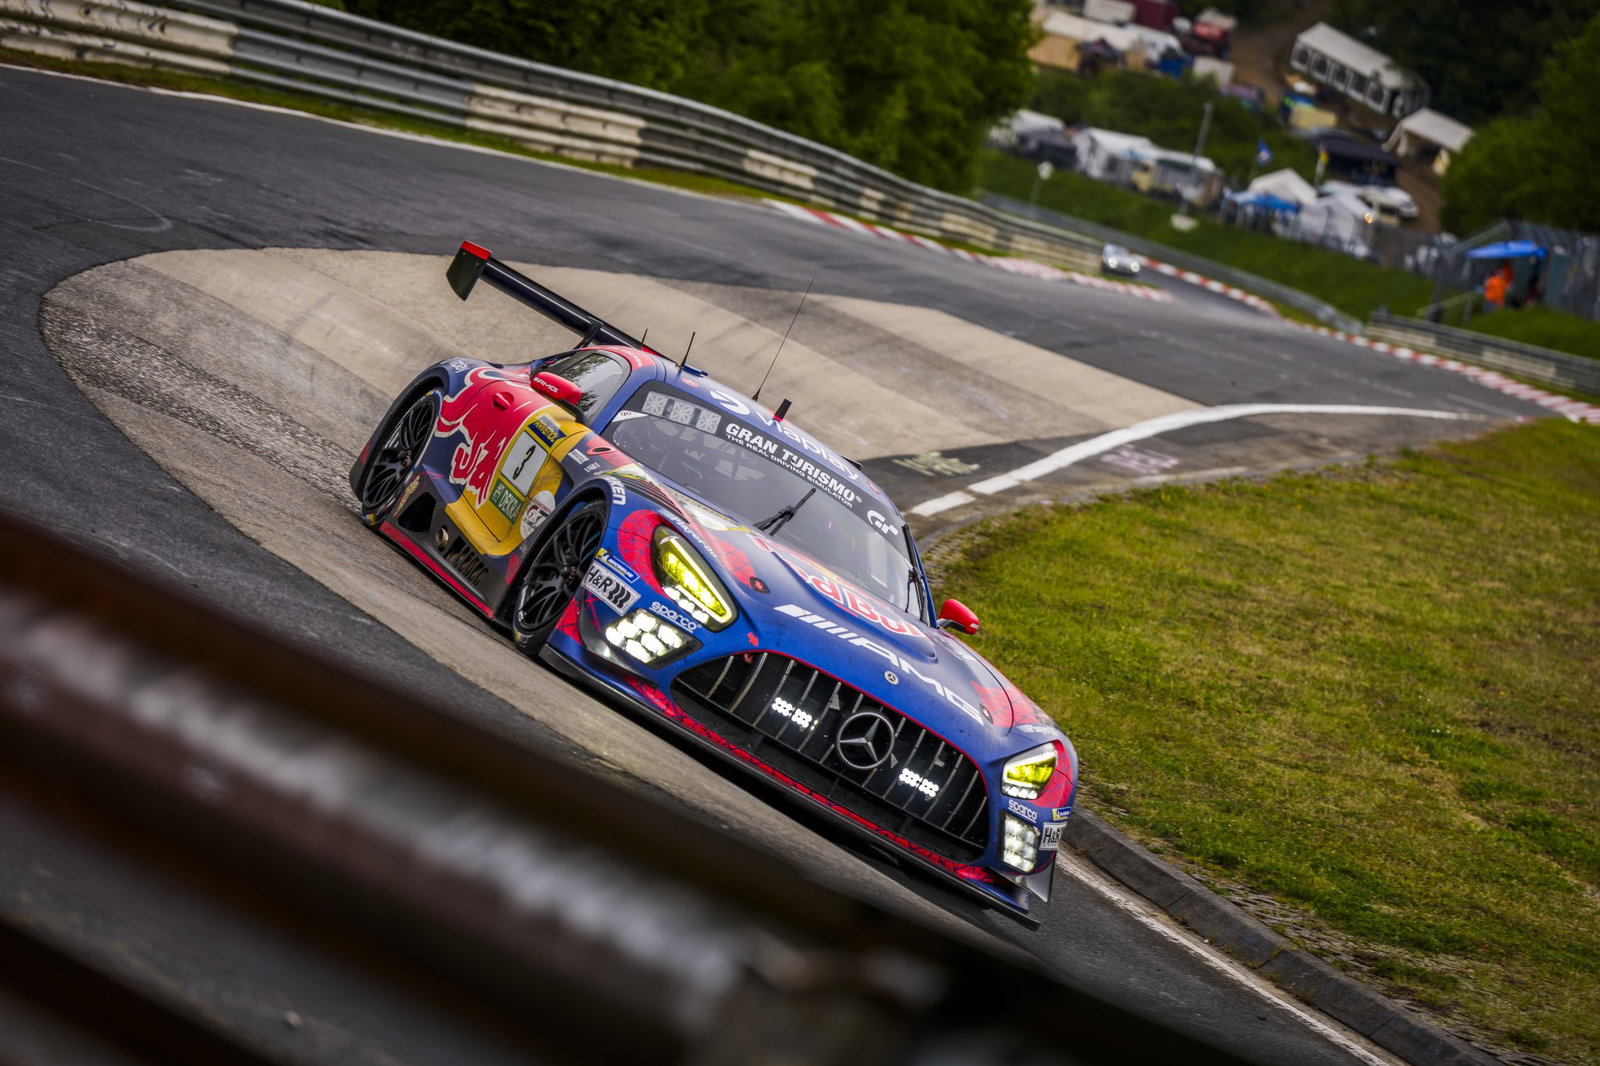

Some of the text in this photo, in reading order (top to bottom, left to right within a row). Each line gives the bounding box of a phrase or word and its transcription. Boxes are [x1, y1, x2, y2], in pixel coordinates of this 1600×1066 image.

[725, 422, 779, 455] GRAN
[512, 444, 536, 480] 3
[726, 434, 854, 508] THE REAL DRIVING SIMULATOR
[498, 489, 522, 524] DEKRA
[587, 564, 614, 591] H&R
[651, 600, 697, 631] sparco
[1008, 799, 1038, 820] sparco
